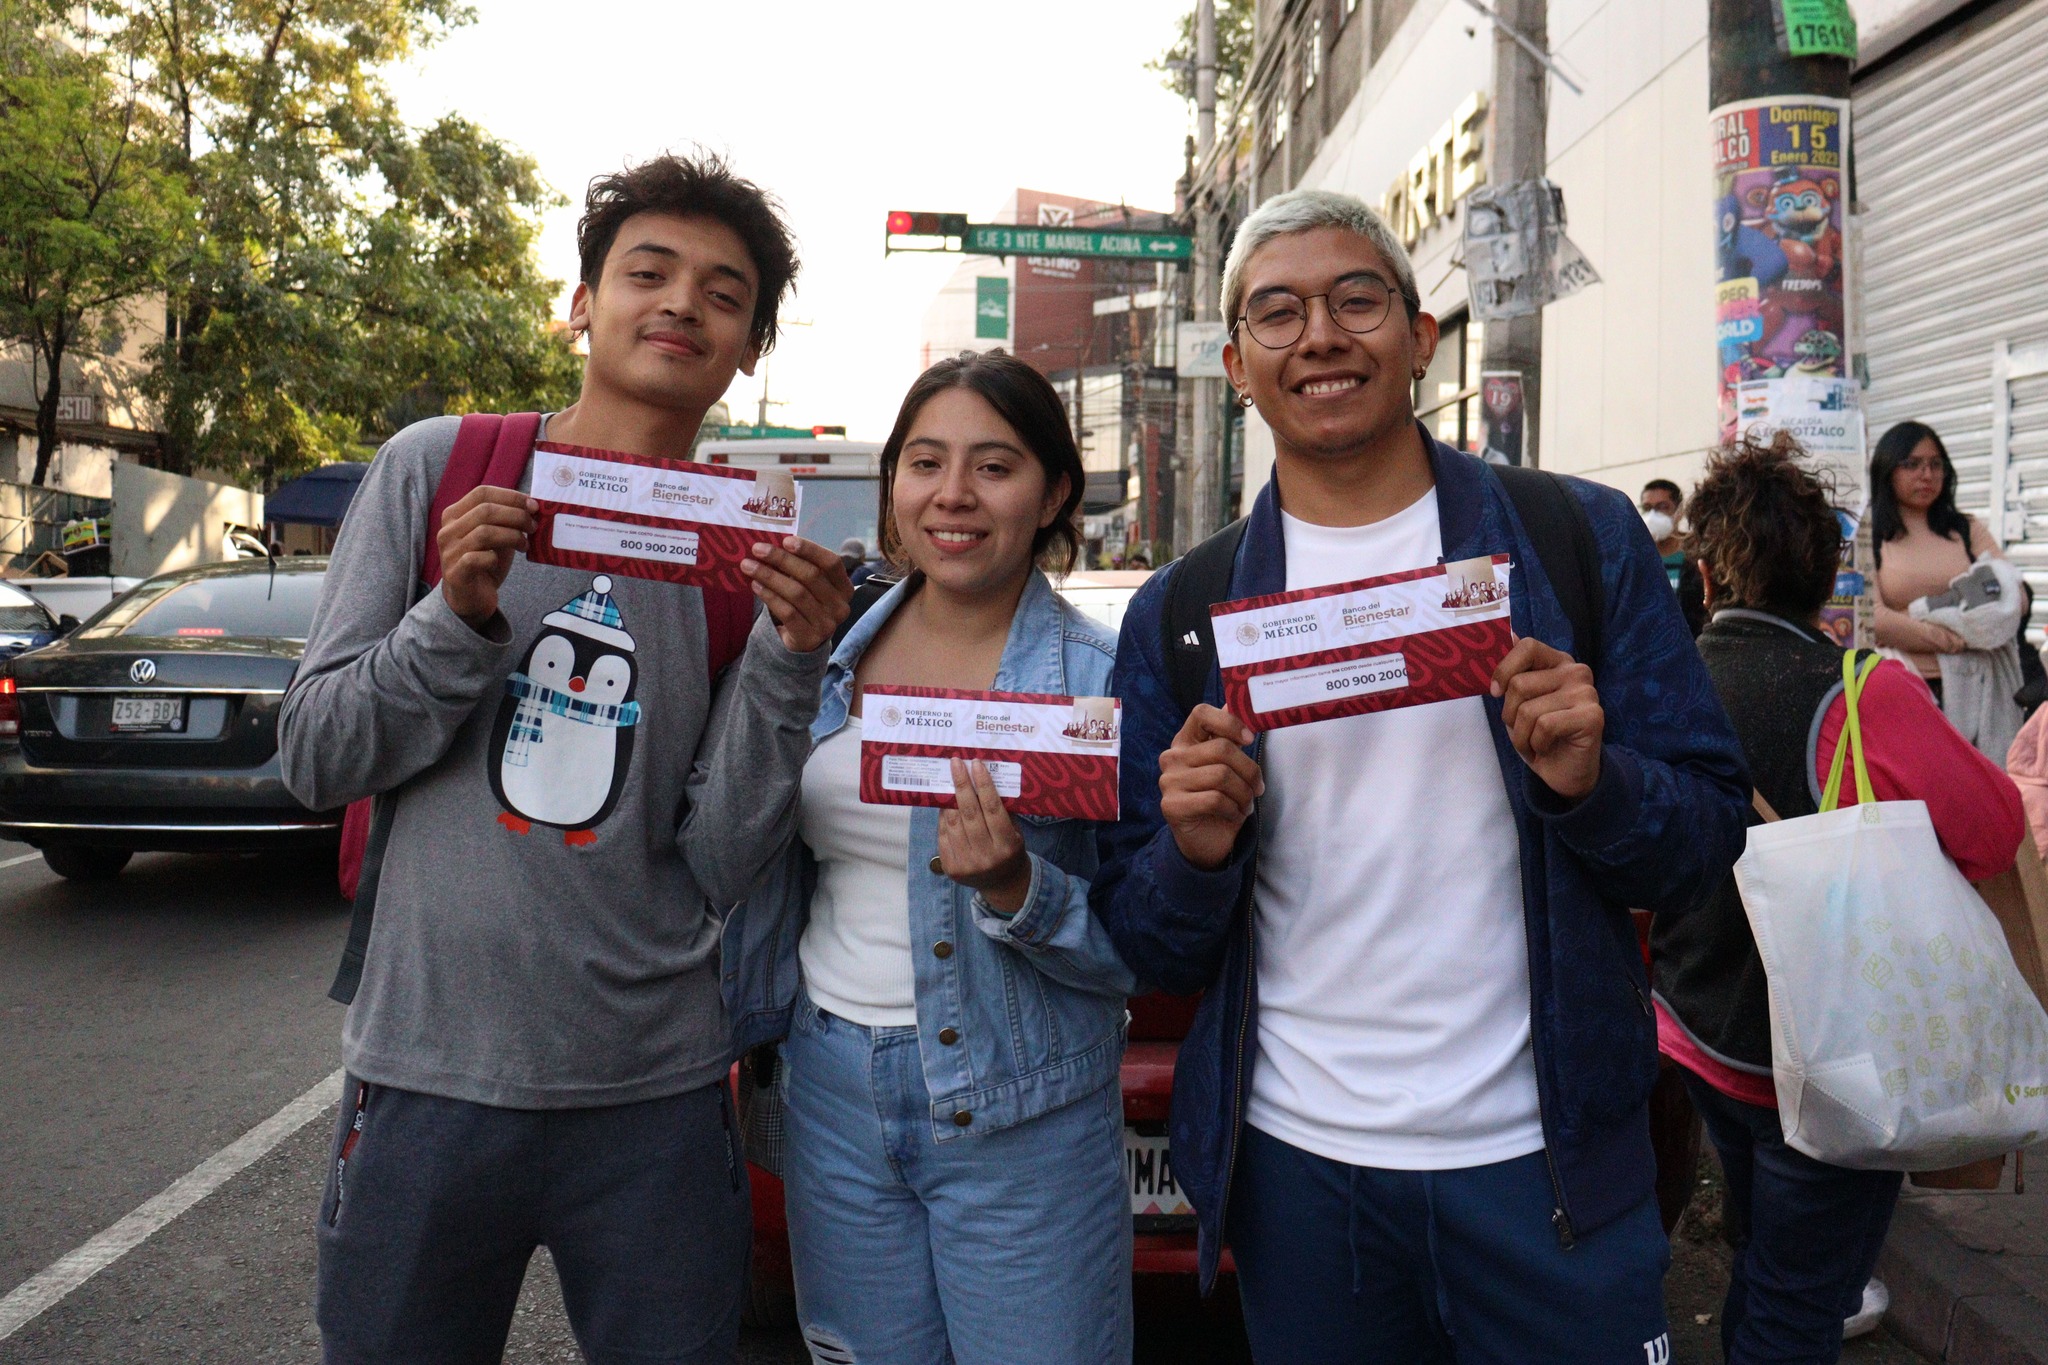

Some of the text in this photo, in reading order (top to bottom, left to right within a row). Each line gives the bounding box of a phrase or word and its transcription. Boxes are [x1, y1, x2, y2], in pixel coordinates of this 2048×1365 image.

[1770, 104, 1838, 128] Domingo
[1770, 150, 1838, 165] Enero 2023
[976, 231, 999, 248] EJE
[1003, 233, 1012, 248] 3
[1016, 233, 1039, 249] NTE
[1044, 234, 1094, 251] MANUEL
[579, 471, 629, 484] GOBIERNO DE
[578, 478, 628, 494] MÉXICO
[653, 481, 676, 490] Banco
[652, 488, 714, 505] Bienestar
[620, 539, 698, 556] 800 900 2000
[1342, 602, 1380, 615] Banco del
[1343, 606, 1410, 626] Bienestar
[1262, 617, 1304, 629] GOBIERNO
[1264, 622, 1318, 640] MÉXICO
[1326, 667, 1408, 691] 800 900 2000
[905, 709, 942, 717] GOBIERNO
[976, 713, 998, 721] Banco
[905, 715, 953, 728] MÉXICO
[975, 720, 1035, 733] Bienestar
[1126, 1149, 1176, 1195] MA
